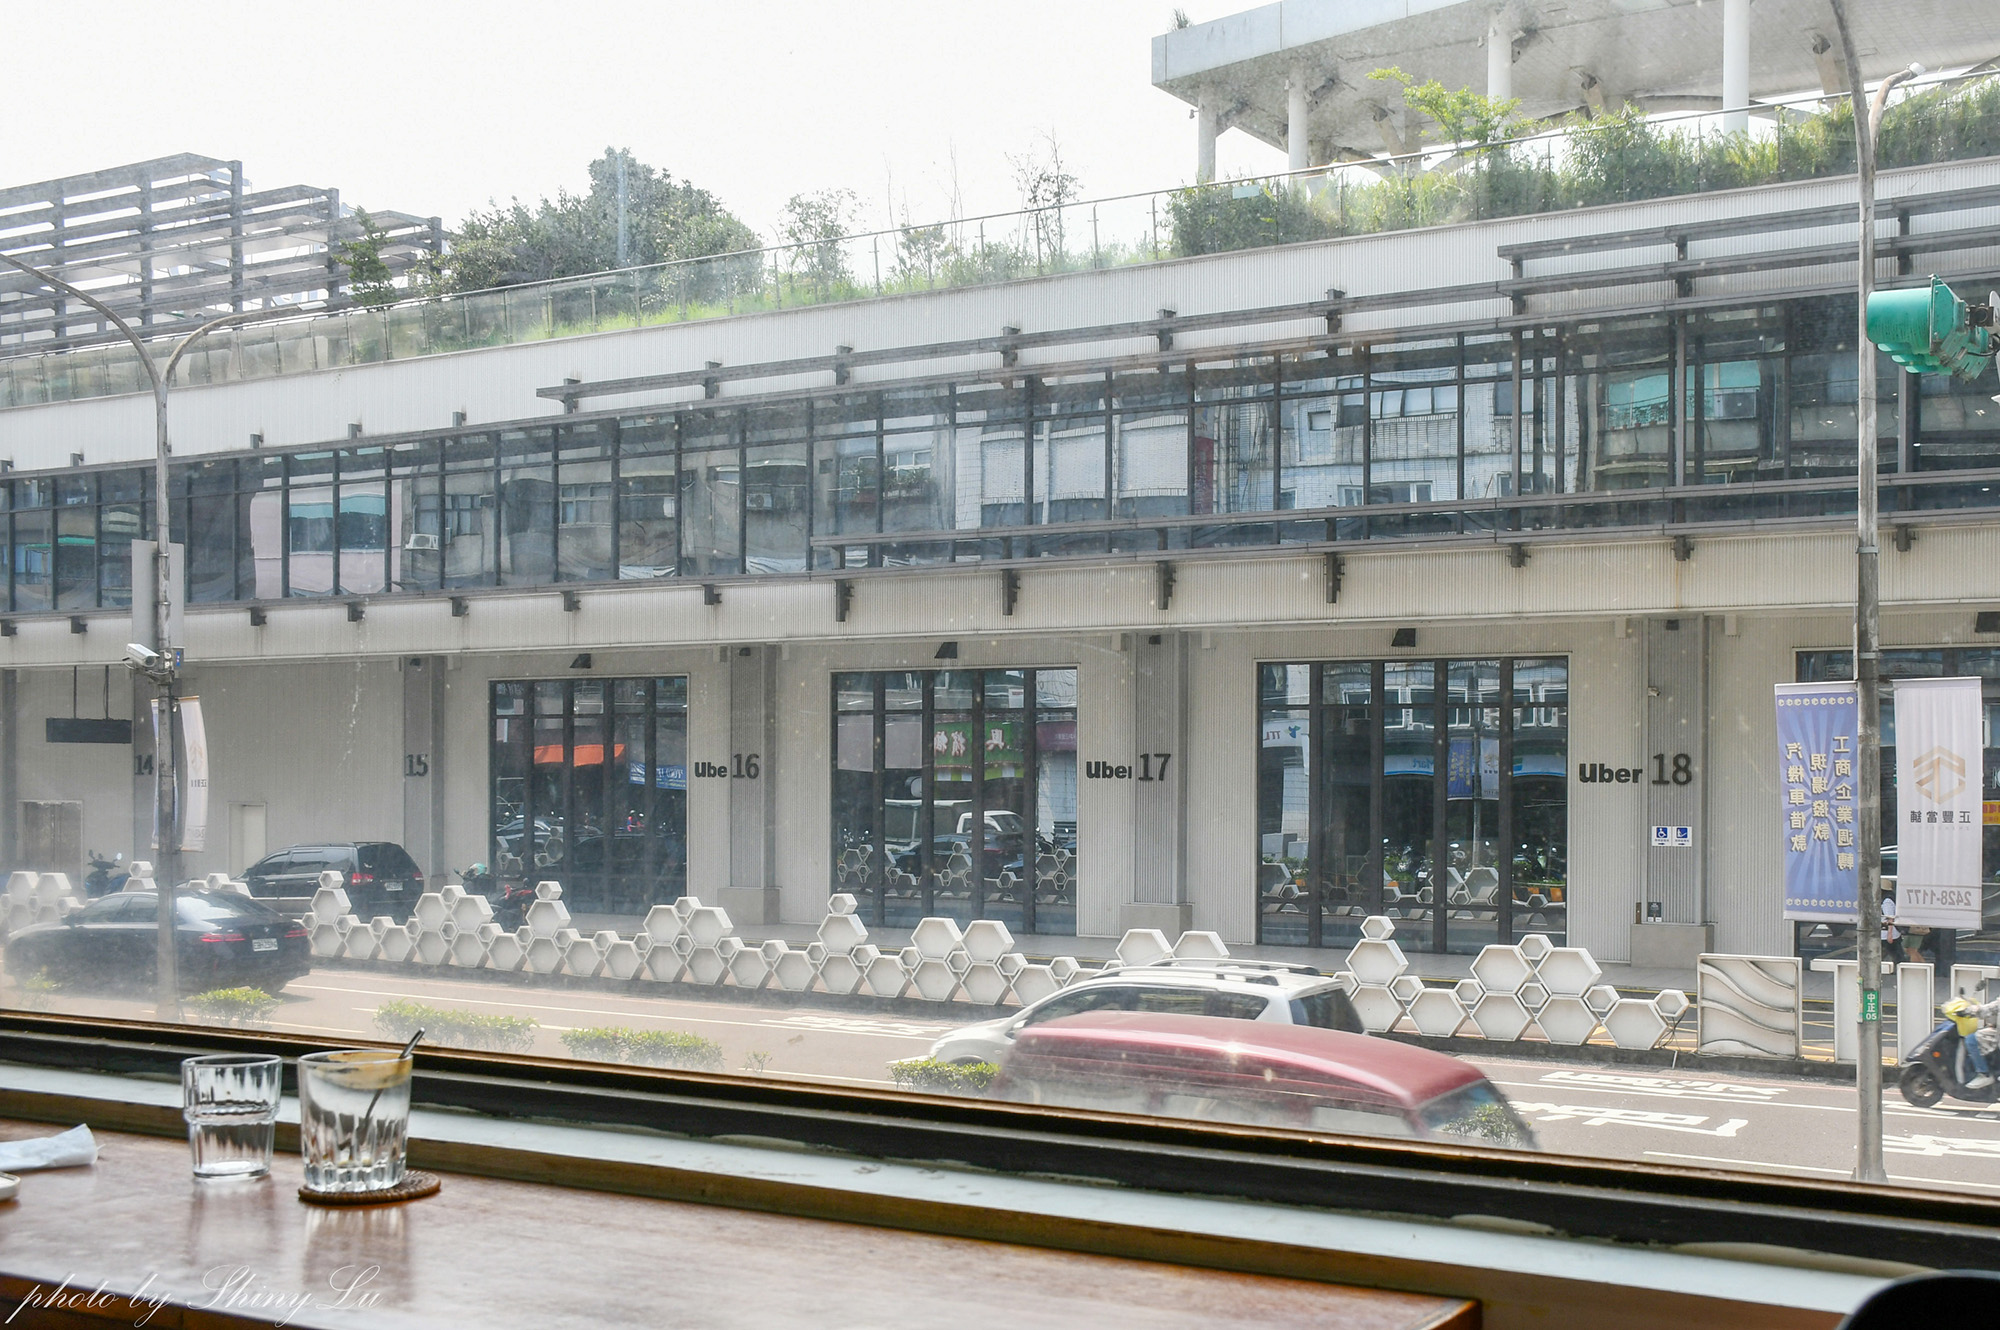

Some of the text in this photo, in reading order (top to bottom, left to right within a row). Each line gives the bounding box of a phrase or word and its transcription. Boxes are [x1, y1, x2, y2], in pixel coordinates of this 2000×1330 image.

[135, 754, 154, 775] 14
[405, 754, 429, 777] 15
[694, 762, 728, 778] Ube
[732, 753, 760, 779] 16
[1138, 753, 1171, 781] 17
[1579, 763, 1643, 783] Uber
[1651, 753, 1692, 785] 18
[1866, 993, 1876, 1012] 中正
